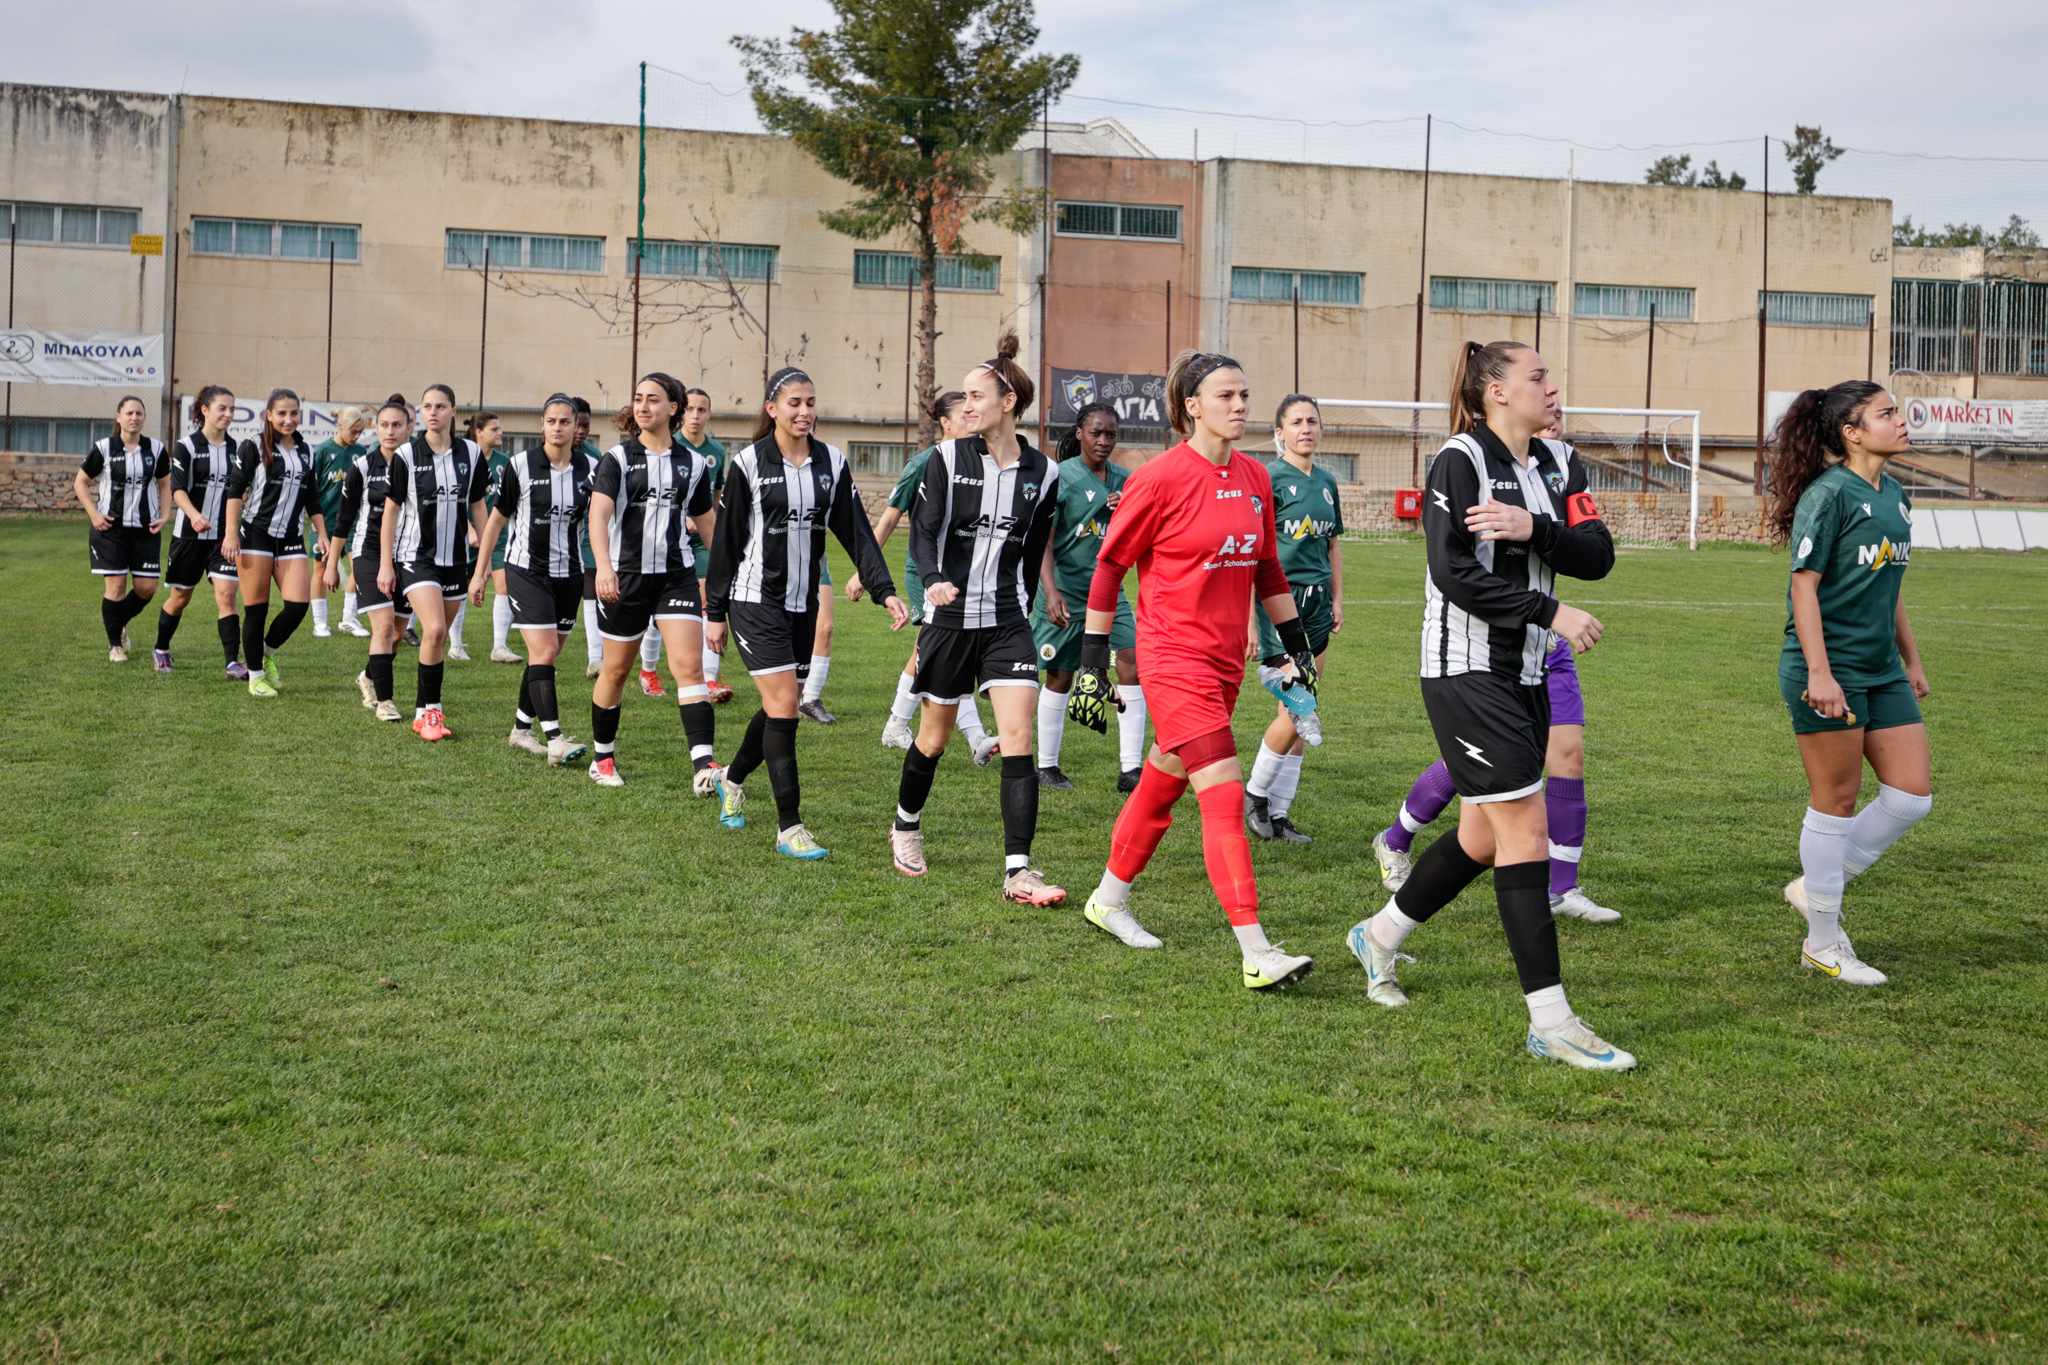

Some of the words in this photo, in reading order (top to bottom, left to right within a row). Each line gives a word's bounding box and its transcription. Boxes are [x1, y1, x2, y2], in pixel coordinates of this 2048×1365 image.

[44, 343, 143, 358] ΜΠΑΚΟΥΛΑ
[1931, 400, 1991, 424] MARKET
[1998, 407, 2013, 425] IN
[757, 476, 784, 486] Zeus
[953, 475, 984, 487] Zeus
[1488, 479, 1519, 490] Zeus
[1216, 489, 1243, 499] Zeus
[1575, 495, 1598, 517] C
[1203, 560, 1222, 571] Sport
[668, 599, 695, 607] Zeus
